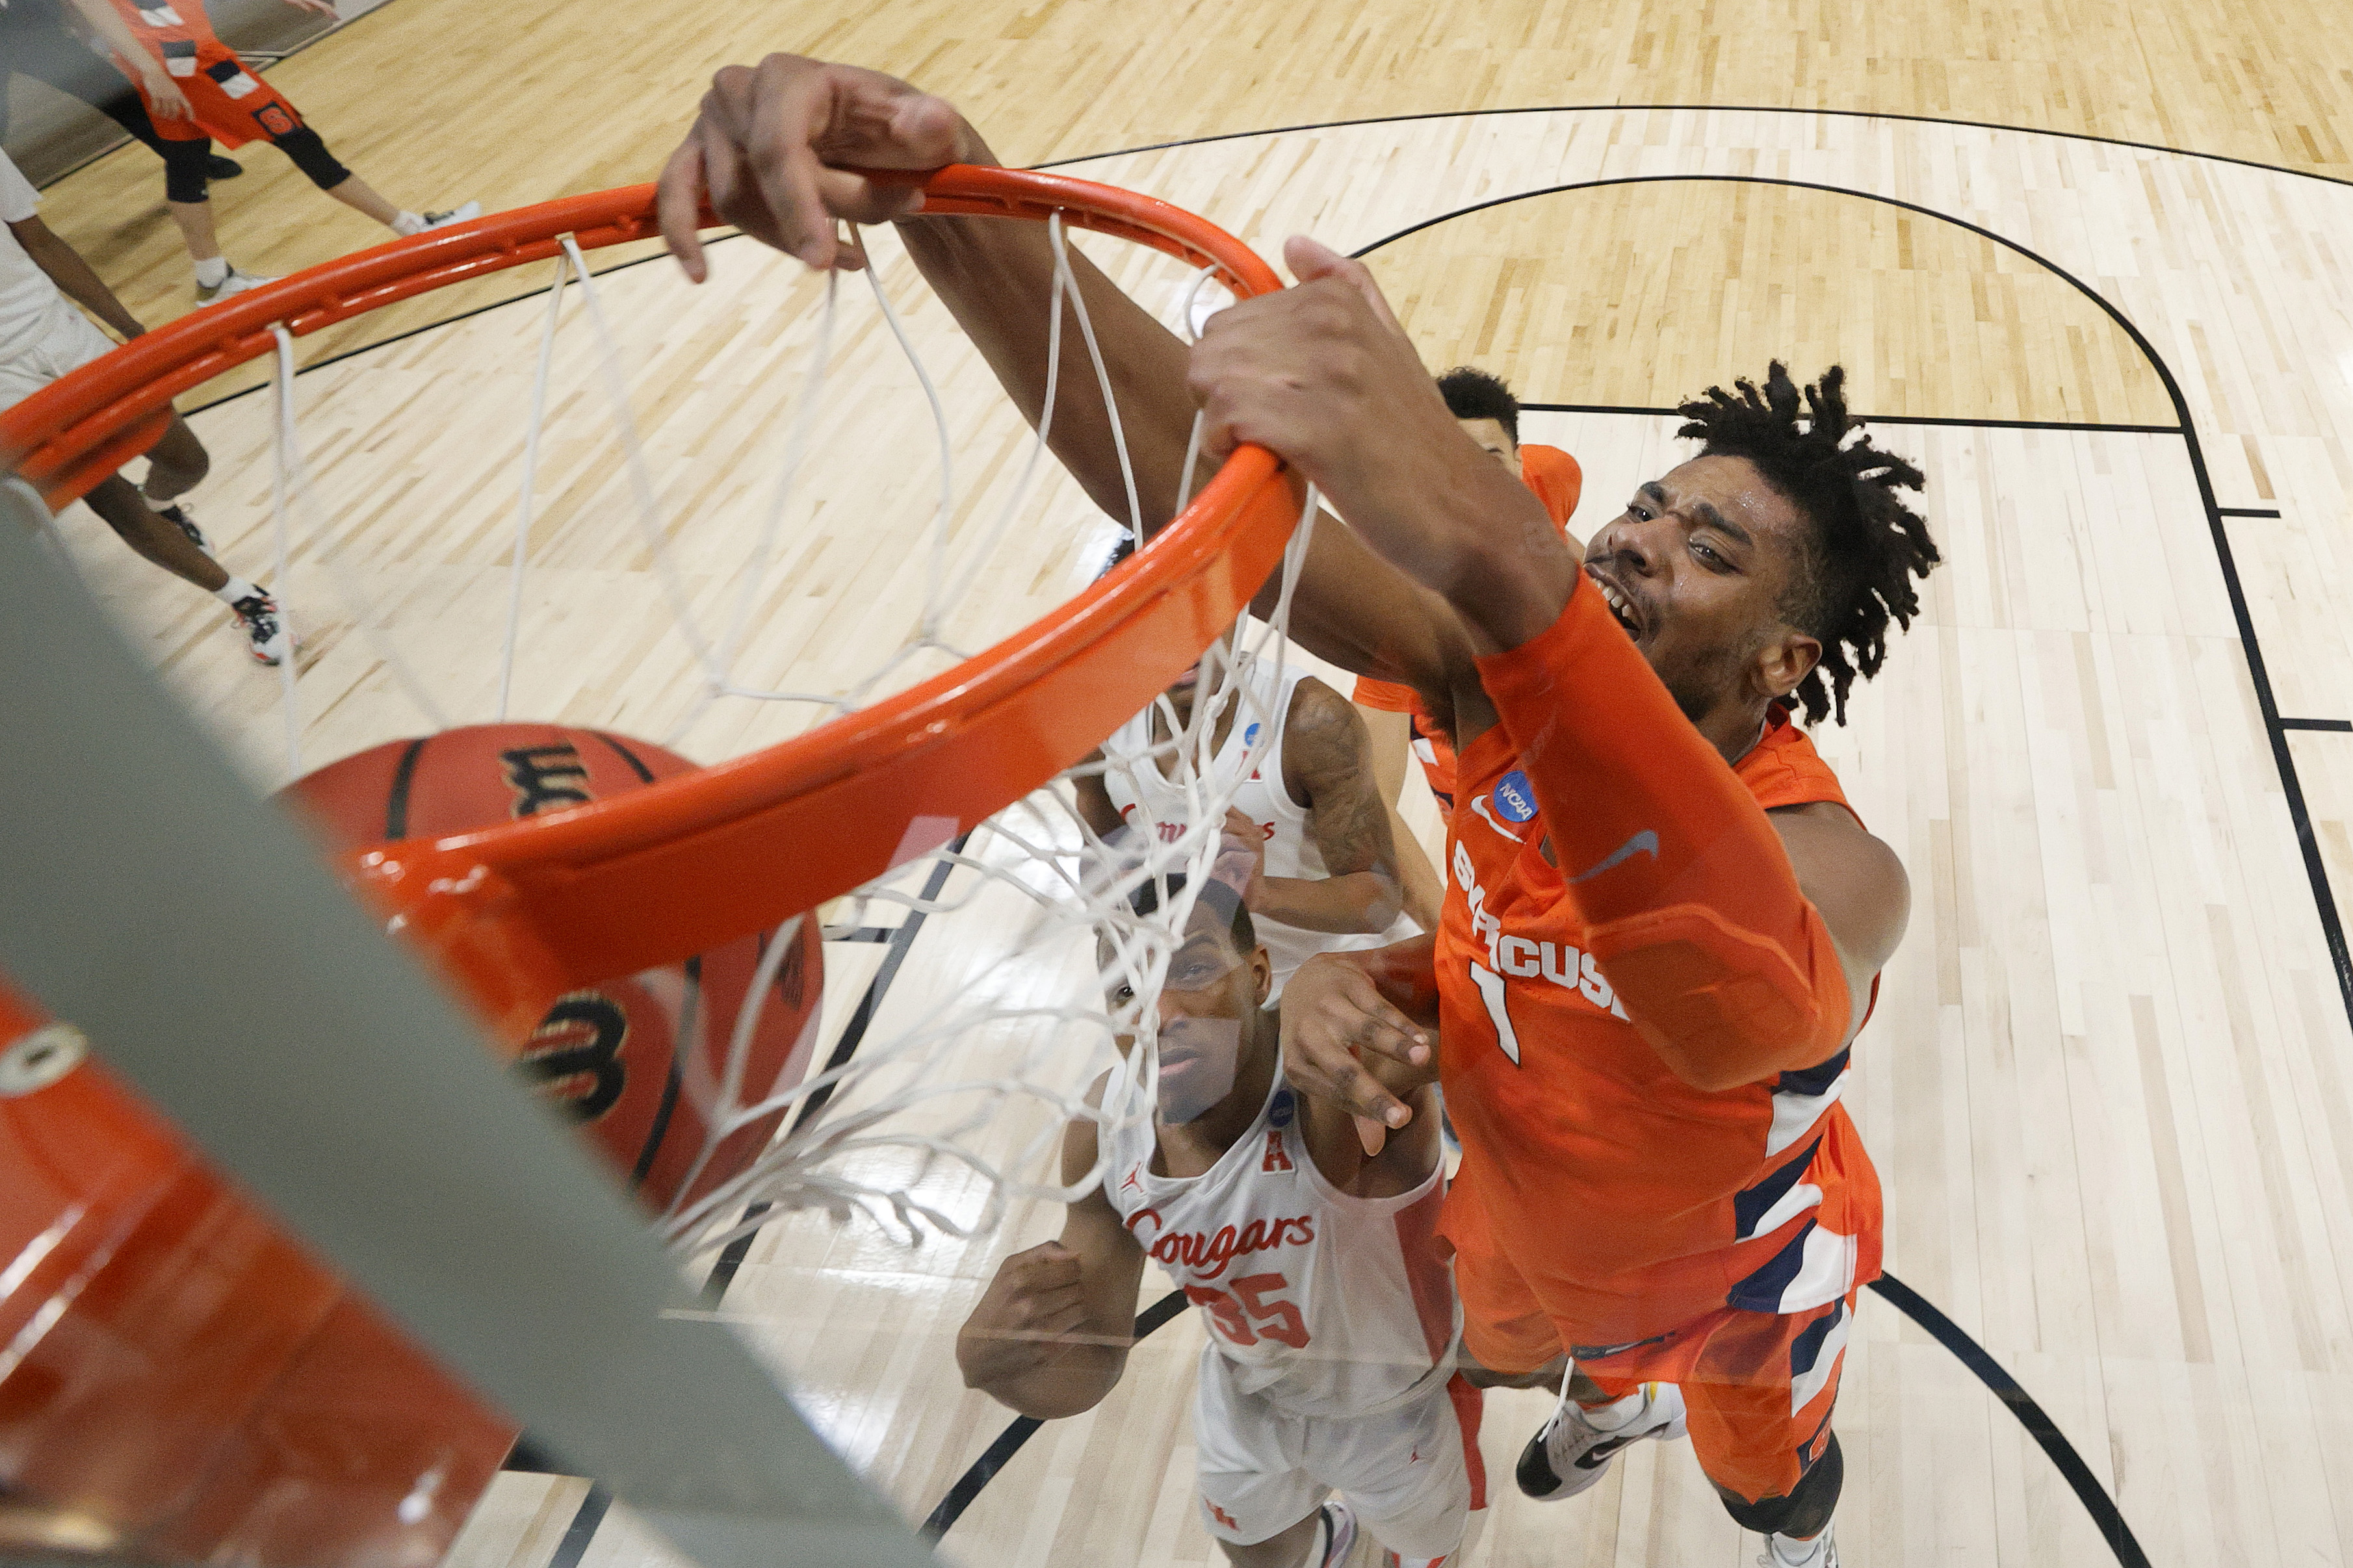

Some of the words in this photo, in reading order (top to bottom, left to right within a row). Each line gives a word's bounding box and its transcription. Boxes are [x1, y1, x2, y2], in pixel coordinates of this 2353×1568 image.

[1499, 783, 1533, 821] NCAA
[1453, 840, 1632, 1022] SYRCUS
[1469, 960, 1521, 1068] 1
[1126, 1208, 1314, 1280] Cougars
[1182, 1272, 1311, 1349] 35
